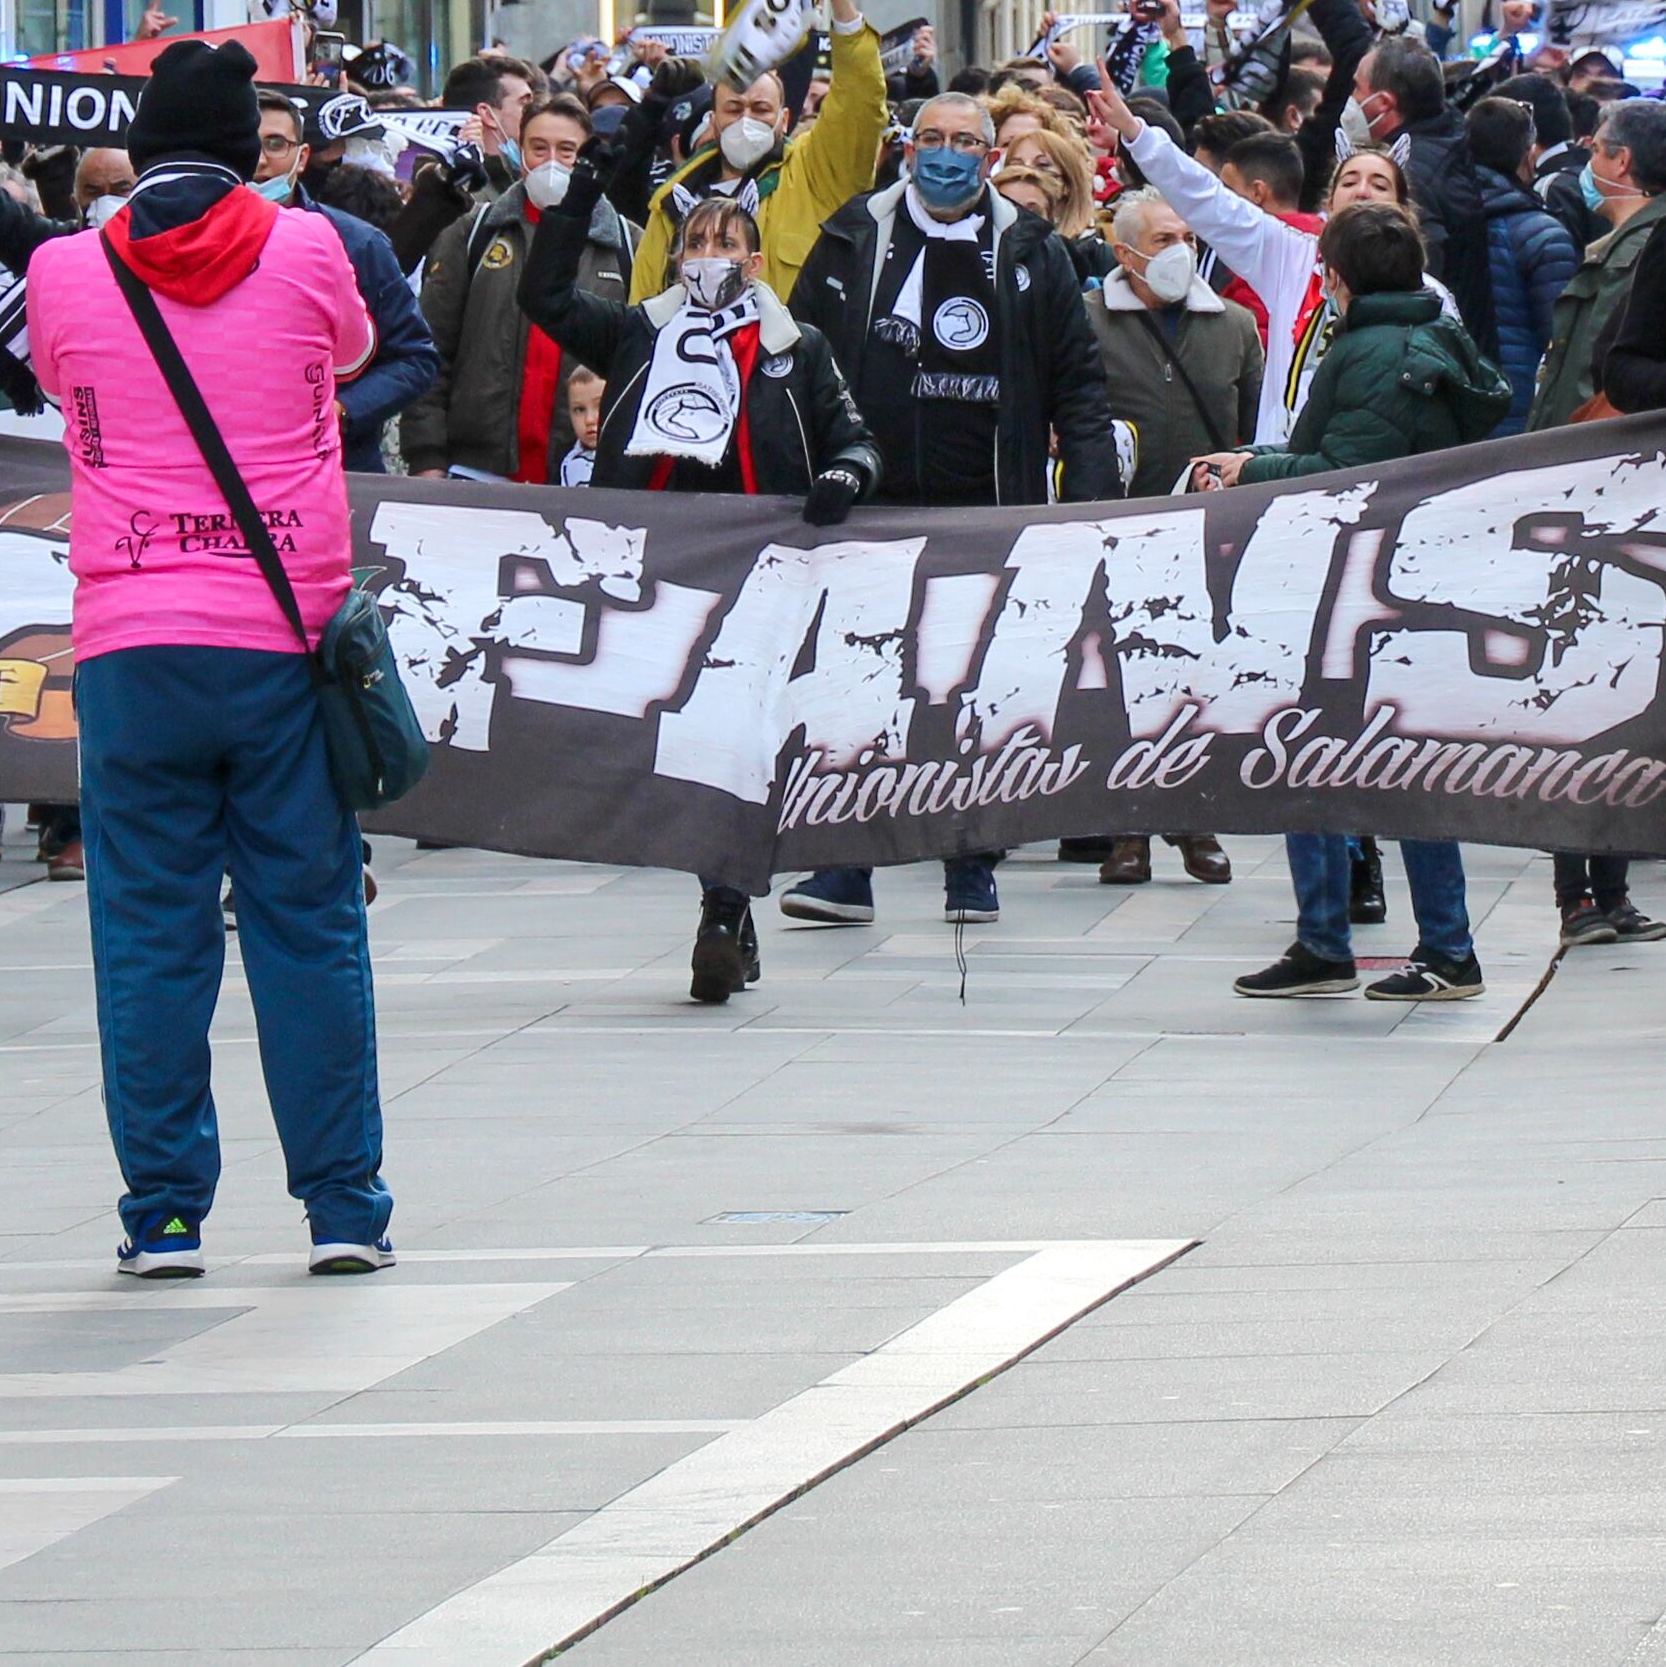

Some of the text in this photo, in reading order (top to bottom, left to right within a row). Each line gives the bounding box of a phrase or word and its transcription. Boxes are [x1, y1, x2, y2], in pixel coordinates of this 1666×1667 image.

[169, 510, 303, 535] TERRA
[180, 533, 297, 554] CHAA
[778, 728, 1091, 834] Unionistas
[1107, 696, 1215, 791] de
